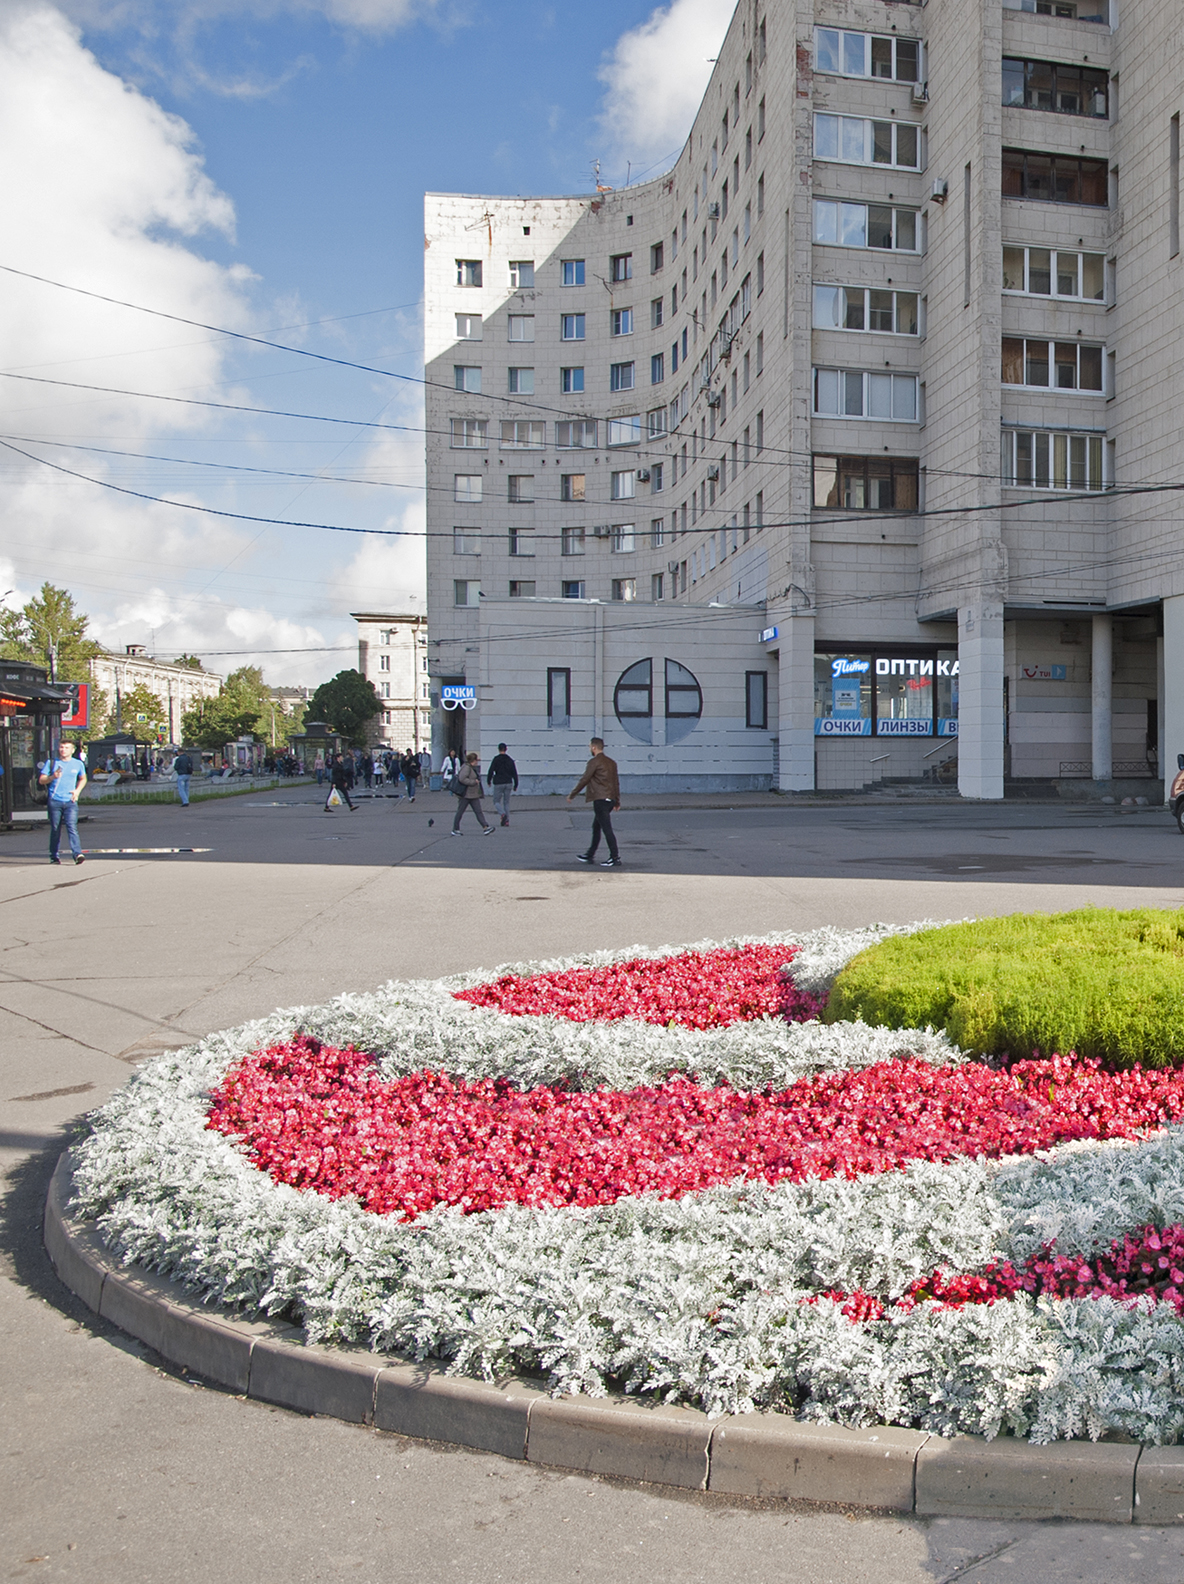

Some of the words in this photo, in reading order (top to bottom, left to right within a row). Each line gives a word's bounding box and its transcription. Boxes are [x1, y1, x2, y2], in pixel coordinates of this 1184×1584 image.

[876, 659, 959, 675] ОПТИКА
[444, 687, 474, 698] ОЧКИ
[823, 721, 861, 732] ОЧКИ
[880, 721, 928, 732] ЛИНЗЫ
